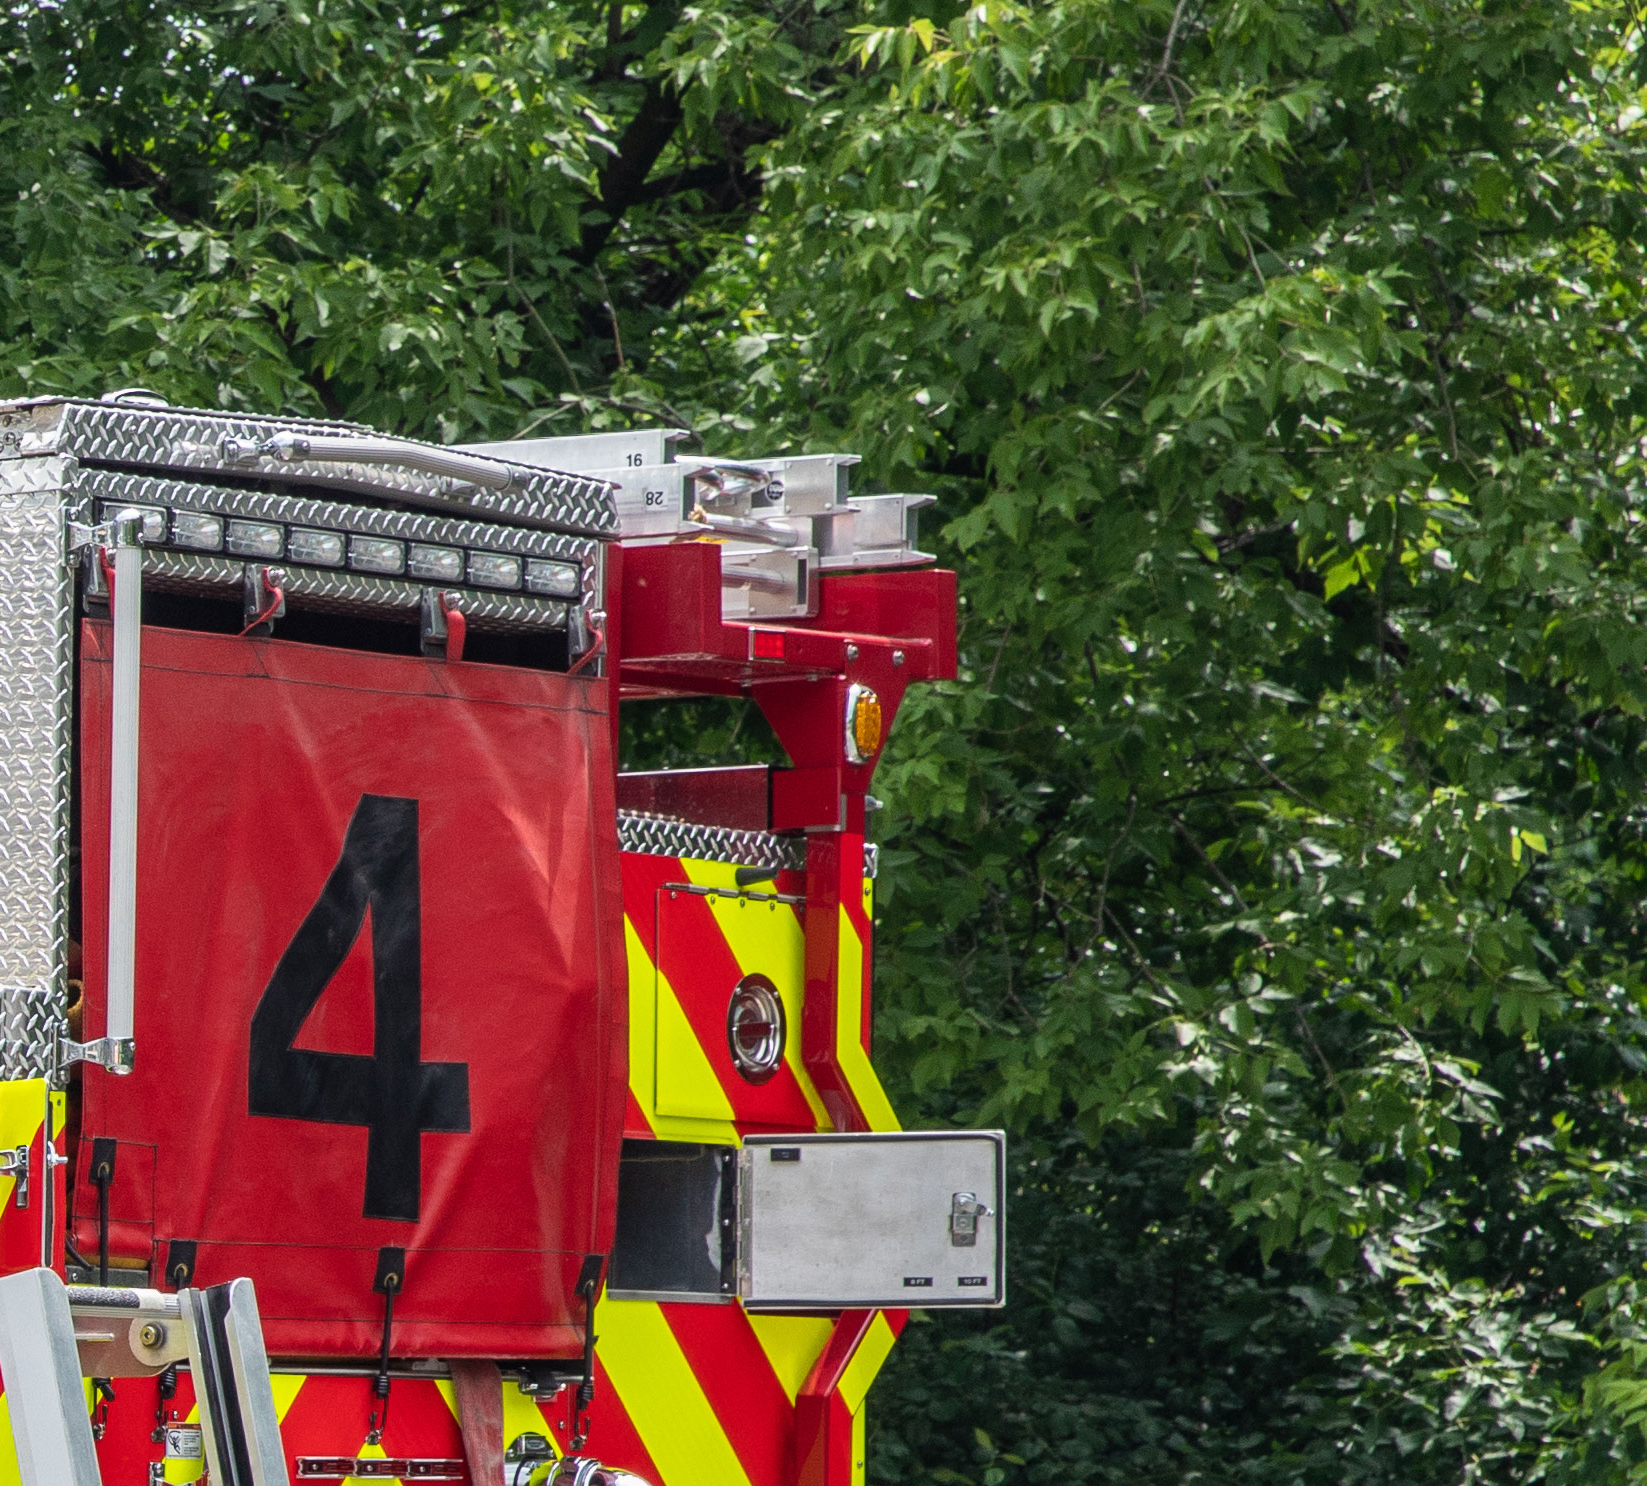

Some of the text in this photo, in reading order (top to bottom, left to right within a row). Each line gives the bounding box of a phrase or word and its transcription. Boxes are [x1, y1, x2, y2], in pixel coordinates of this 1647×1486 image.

[626, 453, 643, 467] 16
[646, 491, 664, 506] 28
[248, 794, 471, 1222] 4
